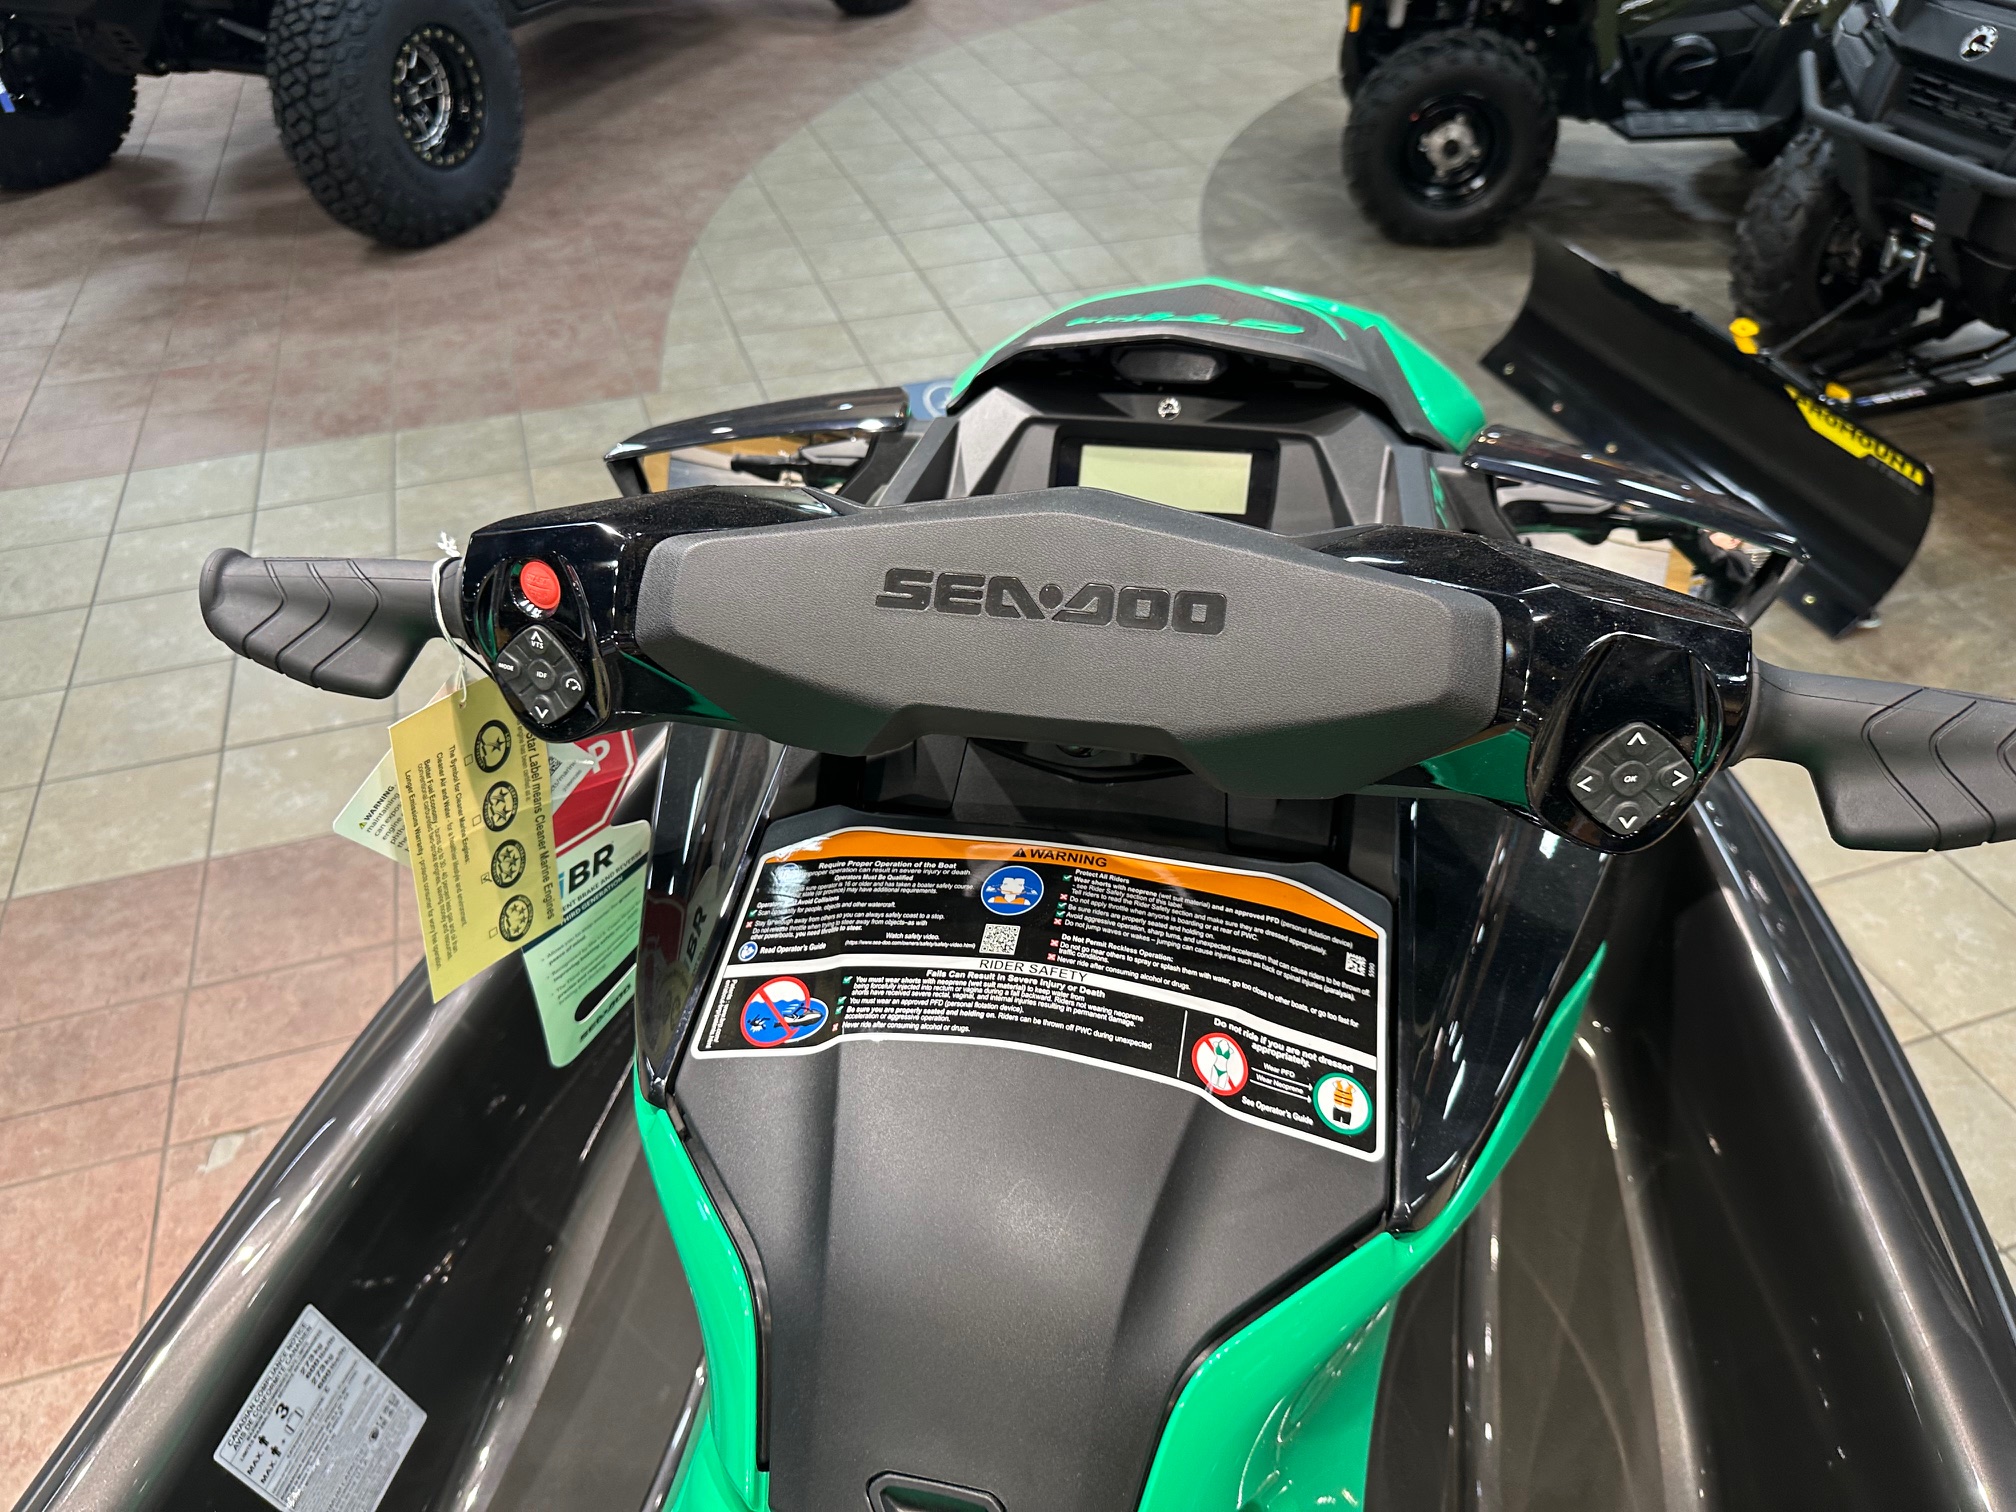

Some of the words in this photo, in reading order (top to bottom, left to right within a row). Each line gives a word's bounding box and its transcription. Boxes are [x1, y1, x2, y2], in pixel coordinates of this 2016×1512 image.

[531, 641, 544, 649] VTS
[499, 663, 514, 671] MODE
[436, 752, 444, 777] Cleaner
[529, 755, 541, 782] Label
[405, 770, 413, 793] Longer
[424, 759, 432, 779] Better
[429, 795, 437, 824] Economy
[441, 788, 449, 800] and
[366, 792, 401, 833] maintaining
[408, 794, 418, 827] Emissions
[443, 801, 451, 818] Water
[450, 758, 459, 782] Symbol
[455, 793, 463, 816] Cleaner
[461, 837, 470, 864] Engines:
[532, 784, 542, 814] means
[374, 823, 386, 837] can
[382, 816, 402, 841] engine
[414, 827, 423, 856] Warranty
[535, 815, 546, 850] Cleaner
[539, 850, 550, 882] Marine
[819, 861, 846, 870] Require
[847, 861, 873, 869] Proper
[874, 861, 912, 869] Operation
[1030, 848, 1107, 867] WARNING
[576, 882, 600, 902] BRAKE
[599, 871, 616, 886] AND
[614, 849, 644, 874] REVERSE
[1075, 868, 1098, 878] Protect
[1109, 874, 1129, 884] Riders
[542, 883, 555, 920] Engines
[581, 875, 624, 911] GENERATION
[1074, 875, 1090, 884] Wear
[1091, 880, 1111, 889] shorts
[1128, 887, 1157, 897] neoprene
[1159, 892, 1171, 900] (wet
[1184, 898, 1210, 910] material)
[1234, 910, 1265, 921] approved
[1266, 915, 1280, 924] PFD
[1092, 908, 1109, 917] riders
[1122, 915, 1146, 926] properly
[1147, 920, 1168, 928] seated
[1182, 926, 1204, 938] holding
[760, 946, 776, 954] Read
[776, 944, 807, 953] Operator's
[809, 943, 826, 951] Guide
[1062, 933, 1071, 941] Do
[1072, 935, 1084, 943] Not
[1085, 937, 1107, 948] Permit
[1108, 942, 1137, 954] Reckless
[1139, 948, 1173, 962] Operation:
[926, 970, 946, 978] Falls
[967, 972, 996, 980] Result
[1008, 974, 1038, 985] Severe
[1079, 985, 1105, 998] Death
[980, 959, 1024, 972] RIDER
[1029, 964, 1088, 982] SAFETY
[1057, 955, 1076, 965] Never
[1090, 963, 1104, 971] after
[1105, 966, 1139, 980] consuming
[1140, 973, 1162, 983] alcohol
[1171, 979, 1191, 990] drugs.
[951, 1025, 970, 1033] drugs.
[1214, 1017, 1227, 1030] Do
[1229, 1025, 1242, 1036] not
[1243, 1030, 1259, 1043] ride
[1260, 1035, 1268, 1045] if
[1268, 1039, 1284, 1050] you
[1286, 1045, 1300, 1056] are
[1302, 1050, 1317, 1061] not
[1318, 1054, 1353, 1074] dressed
[1252, 1043, 1310, 1068] appropriately.
[1256, 1073, 1272, 1084] Wear
[1273, 1079, 1303, 1094] Neoprene
[1264, 1063, 1280, 1075] Wear
[1281, 1067, 1295, 1078] PFD
[1242, 1095, 1254, 1106] See
[1255, 1100, 1291, 1118] Operator's
[1293, 1112, 1313, 1126] Guide
[226, 1403, 256, 1447] CANADIAN
[253, 1351, 289, 1403] COMPLIANCE
[286, 1322, 307, 1351] NOTICE
[232, 1430, 247, 1451] AVIS
[244, 1418, 255, 1431] DE
[246, 1451, 264, 1475] MAX.
[274, 1401, 289, 1419] 3
[260, 1461, 277, 1484] MAX.
